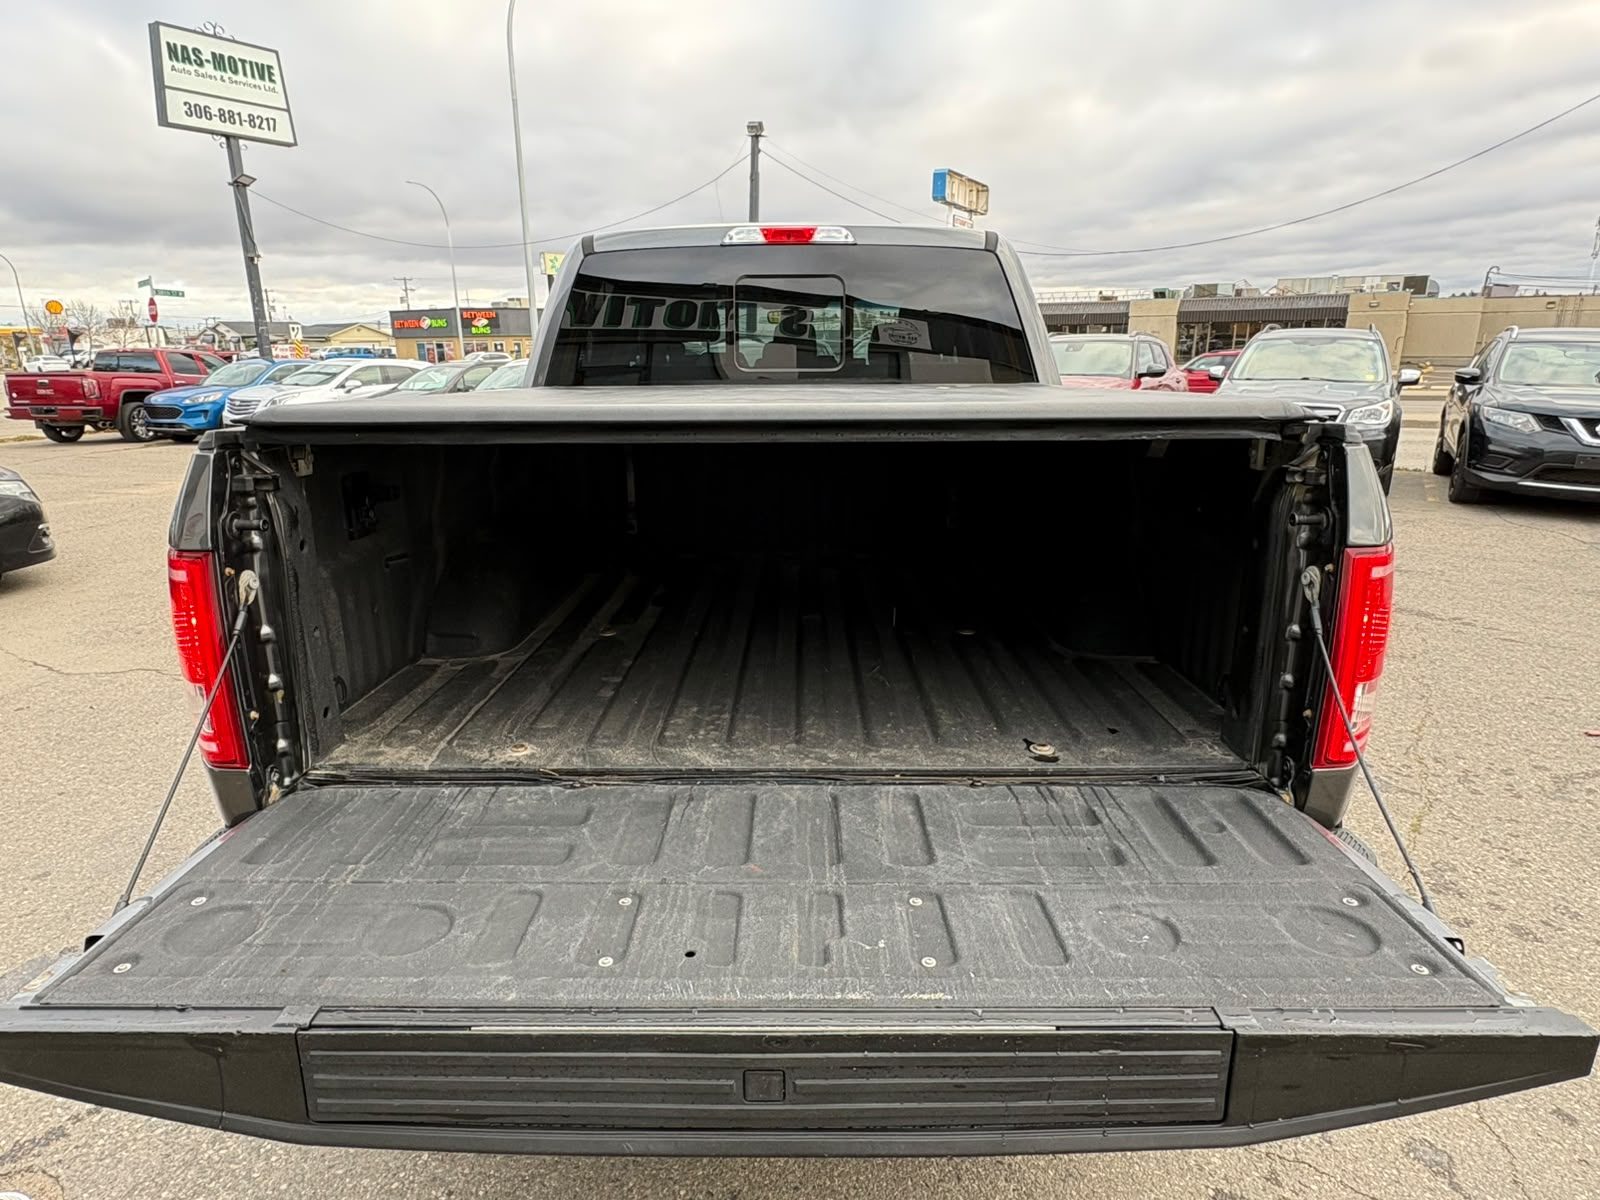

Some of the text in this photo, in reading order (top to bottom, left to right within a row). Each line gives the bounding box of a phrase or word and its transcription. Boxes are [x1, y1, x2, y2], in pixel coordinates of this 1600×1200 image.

[166, 41, 277, 85] NAS-MOTIVE
[170, 64, 279, 94] Auto Sales & Services Ltd.
[183, 101, 277, 133] 306-881-8217
[394, 318, 448, 329] BETWEEN BUNS
[462, 310, 497, 319] BETWEEN
[471, 326, 491, 334] BUNS
